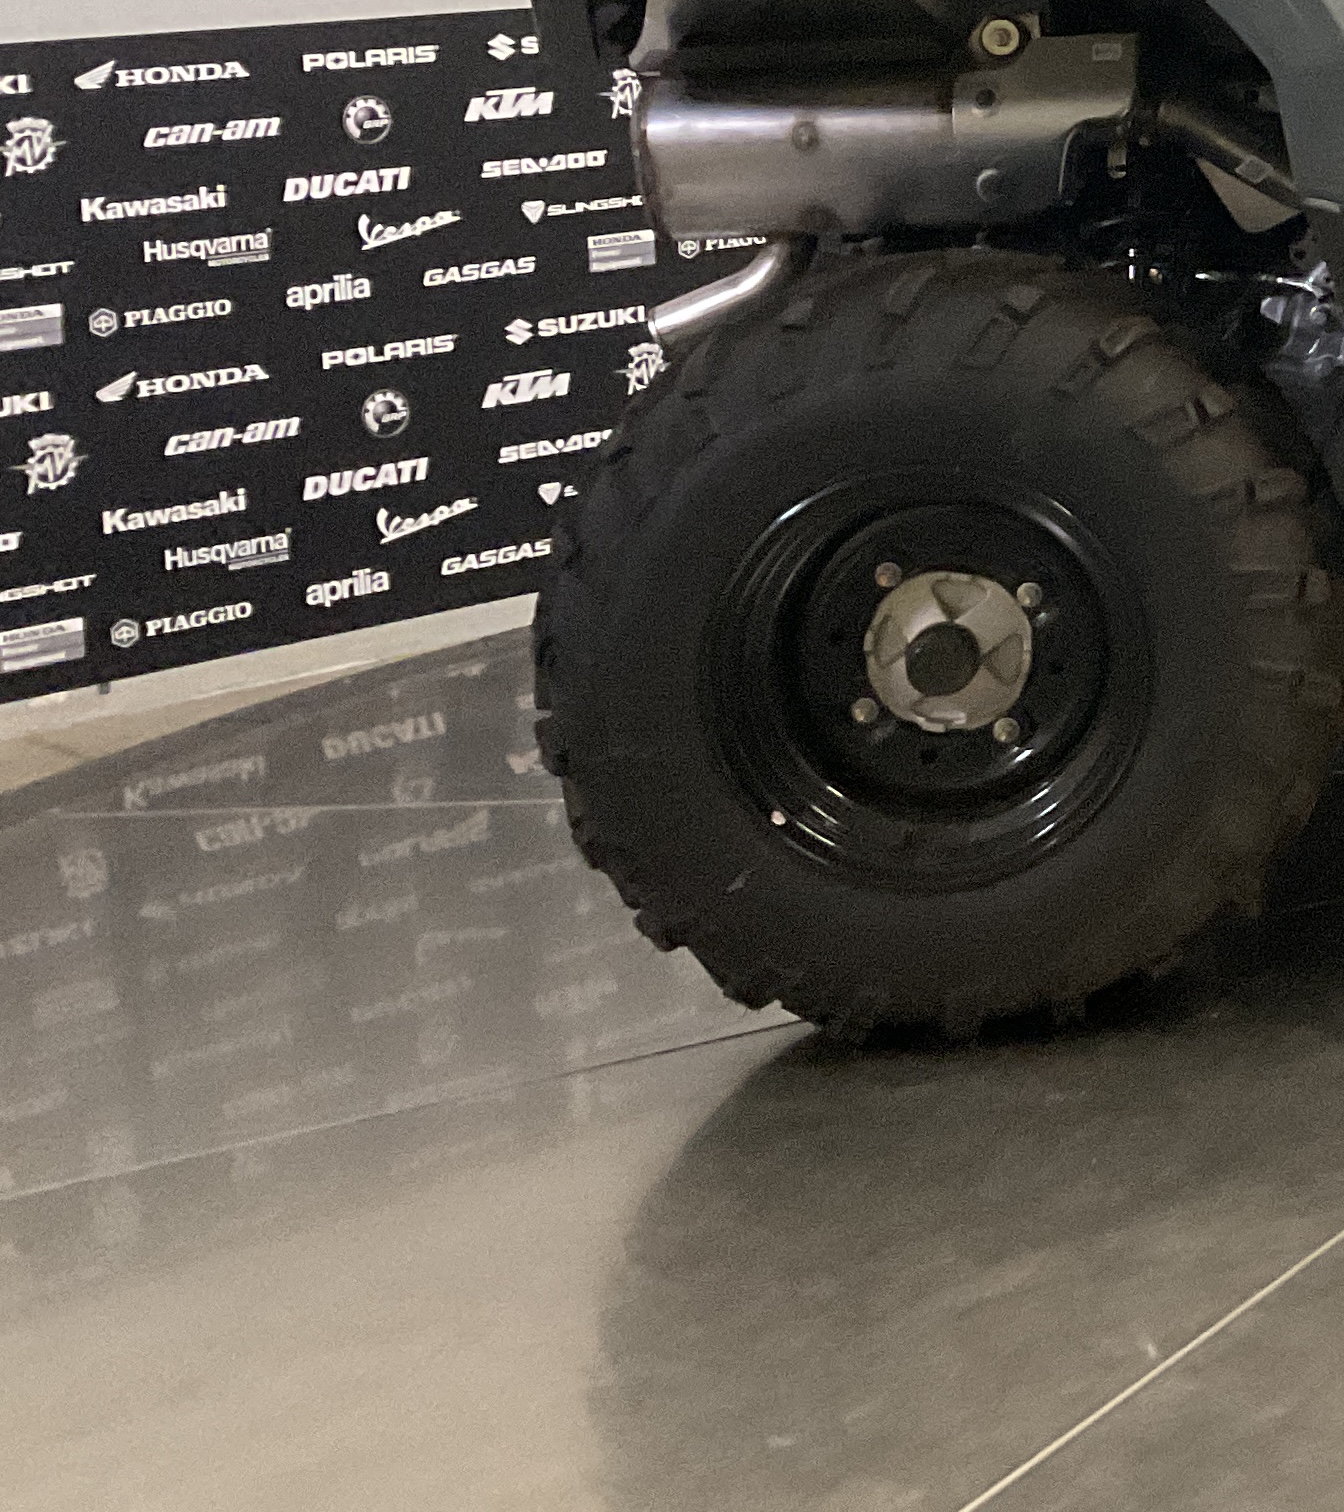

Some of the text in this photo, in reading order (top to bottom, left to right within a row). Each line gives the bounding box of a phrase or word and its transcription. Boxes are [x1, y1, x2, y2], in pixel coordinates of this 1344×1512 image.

[115, 61, 250, 87] HONDA
[303, 45, 439, 72] POLARIS
[464, 87, 554, 121] KTM
[144, 117, 280, 147] can-am
[283, 167, 411, 201] DUCATI
[81, 185, 225, 222] Kawasaki
[143, 228, 272, 263] Husqvarna
[358, 211, 461, 250] Vespa
[423, 257, 536, 286] GASGAS
[286, 274, 370, 310] aprilia
[124, 299, 231, 327] PIAGGIO
[538, 306, 646, 336] SUZUKI
[322, 335, 457, 369] POLARIS
[133, 365, 269, 397] HONDA
[482, 369, 570, 408] KTM
[165, 417, 300, 456] can-am
[303, 457, 428, 500] DUCATI
[103, 488, 246, 534] Kawasaki
[377, 498, 478, 544] Vespa
[164, 529, 290, 570] Husqvarna
[441, 538, 552, 575] GASGAS
[306, 568, 389, 607] aprilia
[146, 602, 252, 636] PIAGGIO
